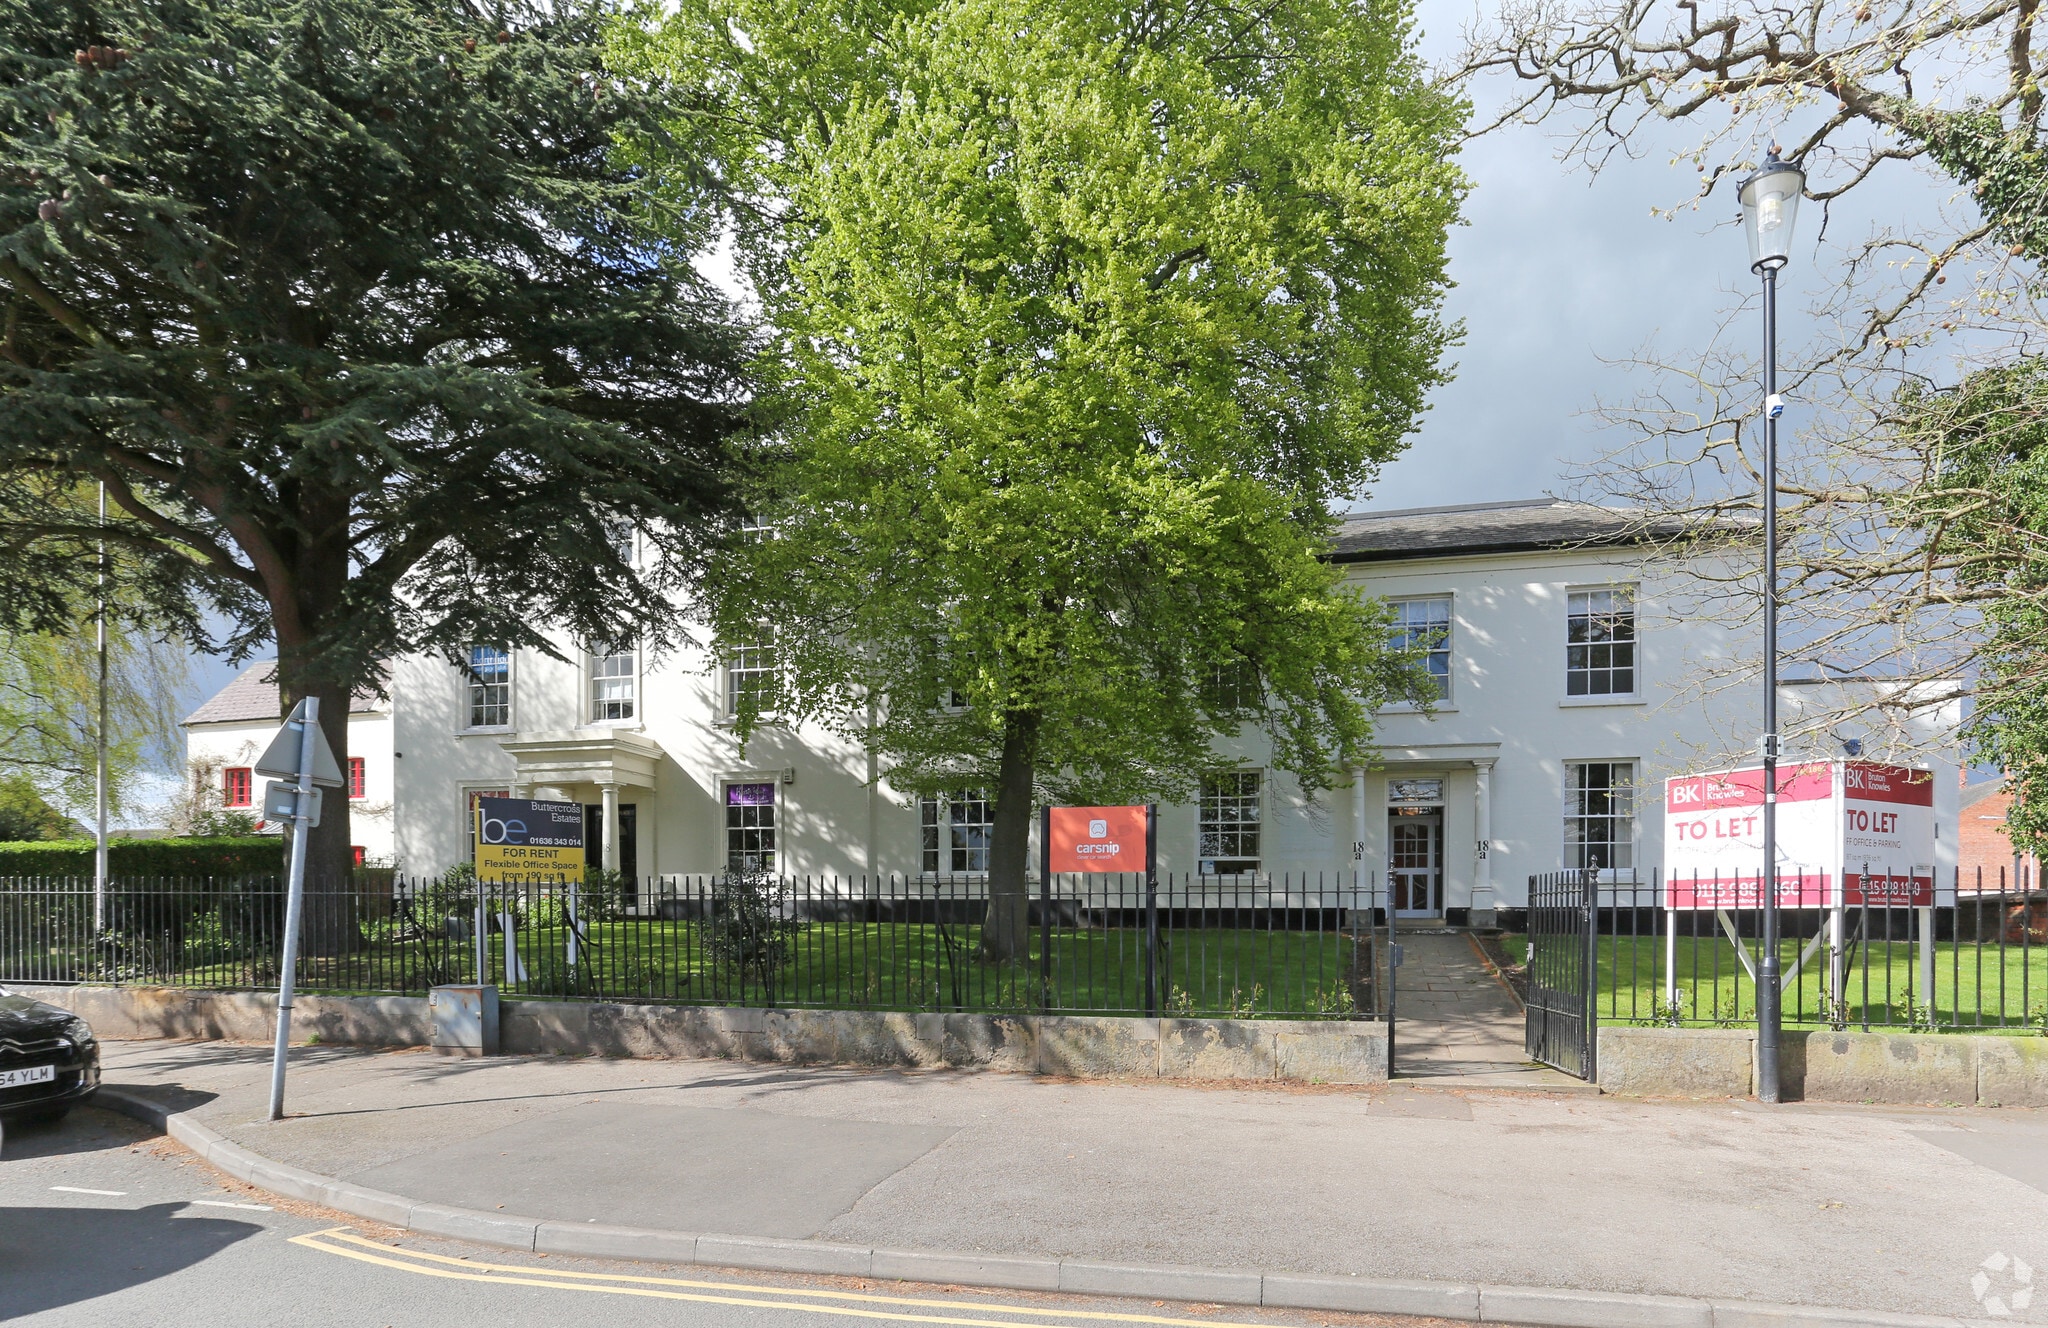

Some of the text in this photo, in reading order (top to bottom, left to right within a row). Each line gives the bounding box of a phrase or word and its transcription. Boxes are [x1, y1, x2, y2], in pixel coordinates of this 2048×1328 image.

[1845, 769, 1865, 789] BK
[1867, 772, 1886, 782] Bruton
[1867, 781, 1891, 792] Knowles
[1673, 784, 1701, 804] BK
[531, 801, 581, 814] Buttercross
[551, 813, 581, 824] Estates
[1847, 809, 1898, 833] TO LET
[1675, 816, 1758, 841] TO LET
[529, 837, 553, 845] 01636
[569, 838, 582, 846] 014
[1353, 841, 1364, 853] 18
[1477, 840, 1489, 852] 18
[1853, 837, 1872, 848] OFFICE
[1878, 839, 1901, 849] PARKING
[503, 848, 560, 859] FOR RENT
[1076, 841, 1120, 856] carsnip
[484, 859, 578, 870] Flexible Office Space
[502, 870, 524, 880] from
[526, 872, 542, 880] 190
[20, 1068, 48, 1082] YLM
